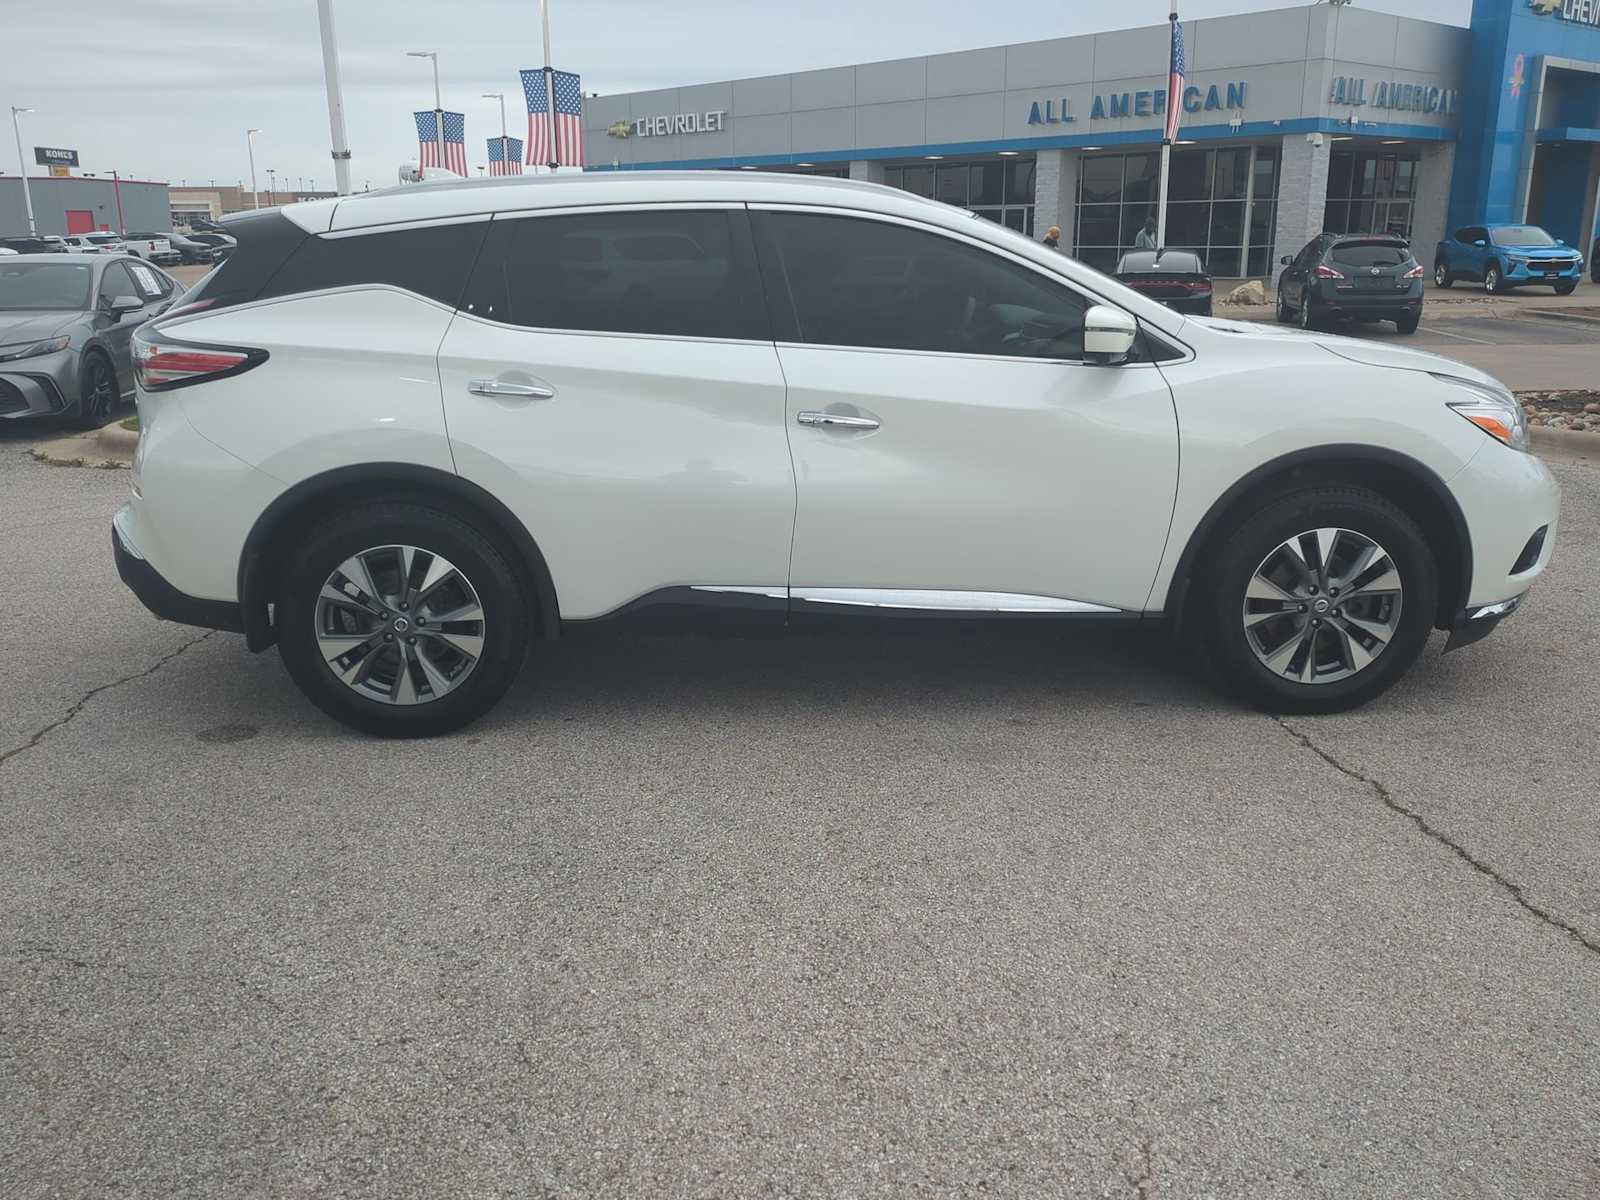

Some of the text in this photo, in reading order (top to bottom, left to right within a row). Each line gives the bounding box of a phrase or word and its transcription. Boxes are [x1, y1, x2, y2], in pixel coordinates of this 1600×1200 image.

[1028, 82, 1246, 125] ALL AMERCAN
[1329, 76, 1367, 107] ALL
[636, 110, 724, 137] CHEVROLET
